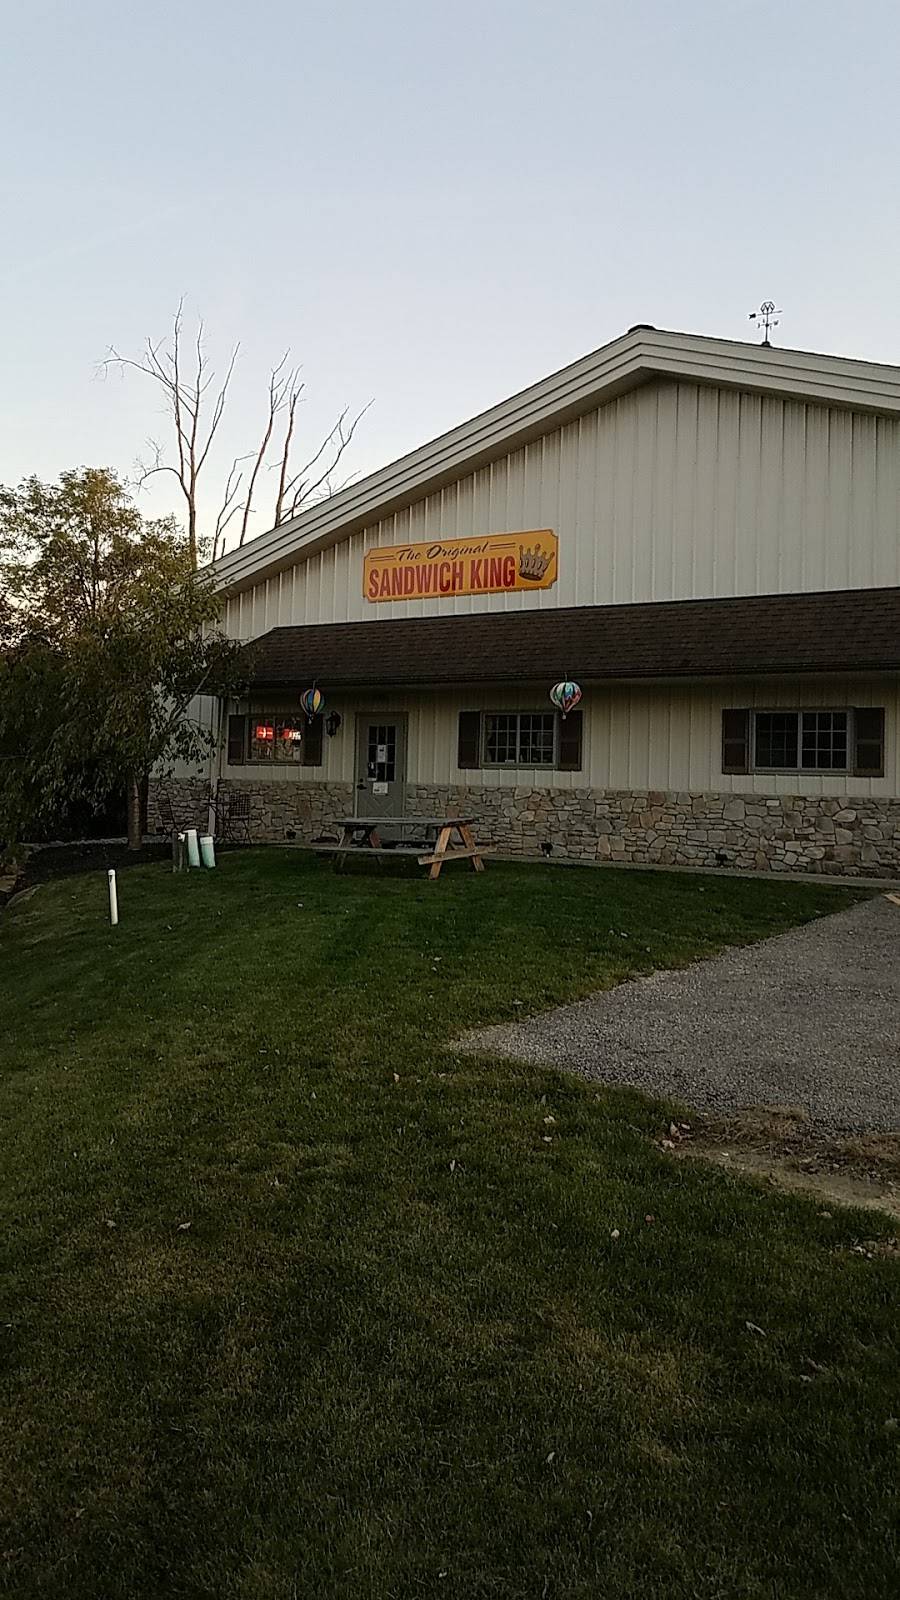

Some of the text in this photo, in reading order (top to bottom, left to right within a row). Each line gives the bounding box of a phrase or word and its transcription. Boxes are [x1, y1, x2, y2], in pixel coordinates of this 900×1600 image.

[396, 541, 489, 562] The Original
[368, 556, 515, 598] SANDWICH KING
